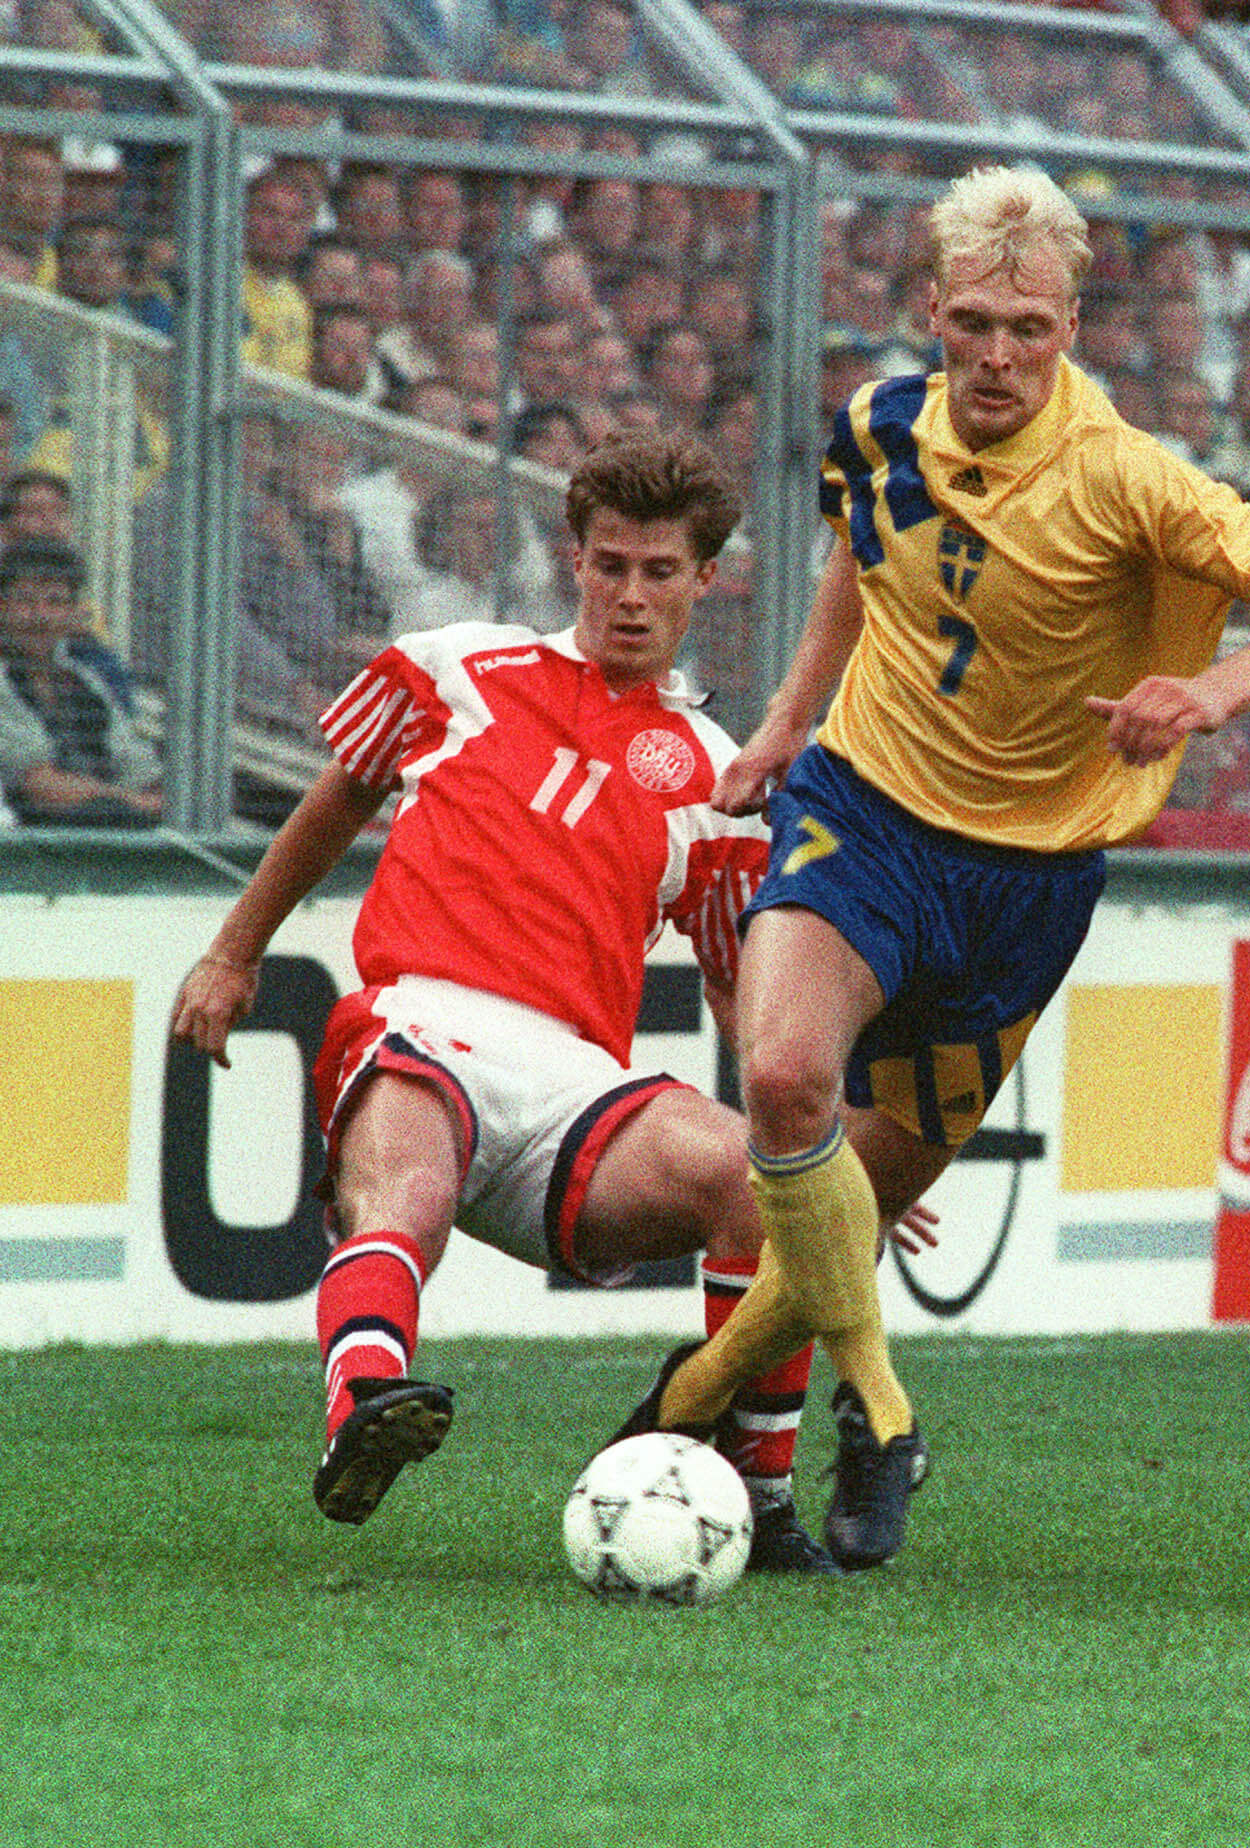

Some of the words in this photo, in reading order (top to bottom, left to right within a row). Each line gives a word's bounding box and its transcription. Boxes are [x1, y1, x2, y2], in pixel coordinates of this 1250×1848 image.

[936, 614, 977, 697] 7
[530, 747, 612, 829] 11
[782, 814, 841, 876] 7
